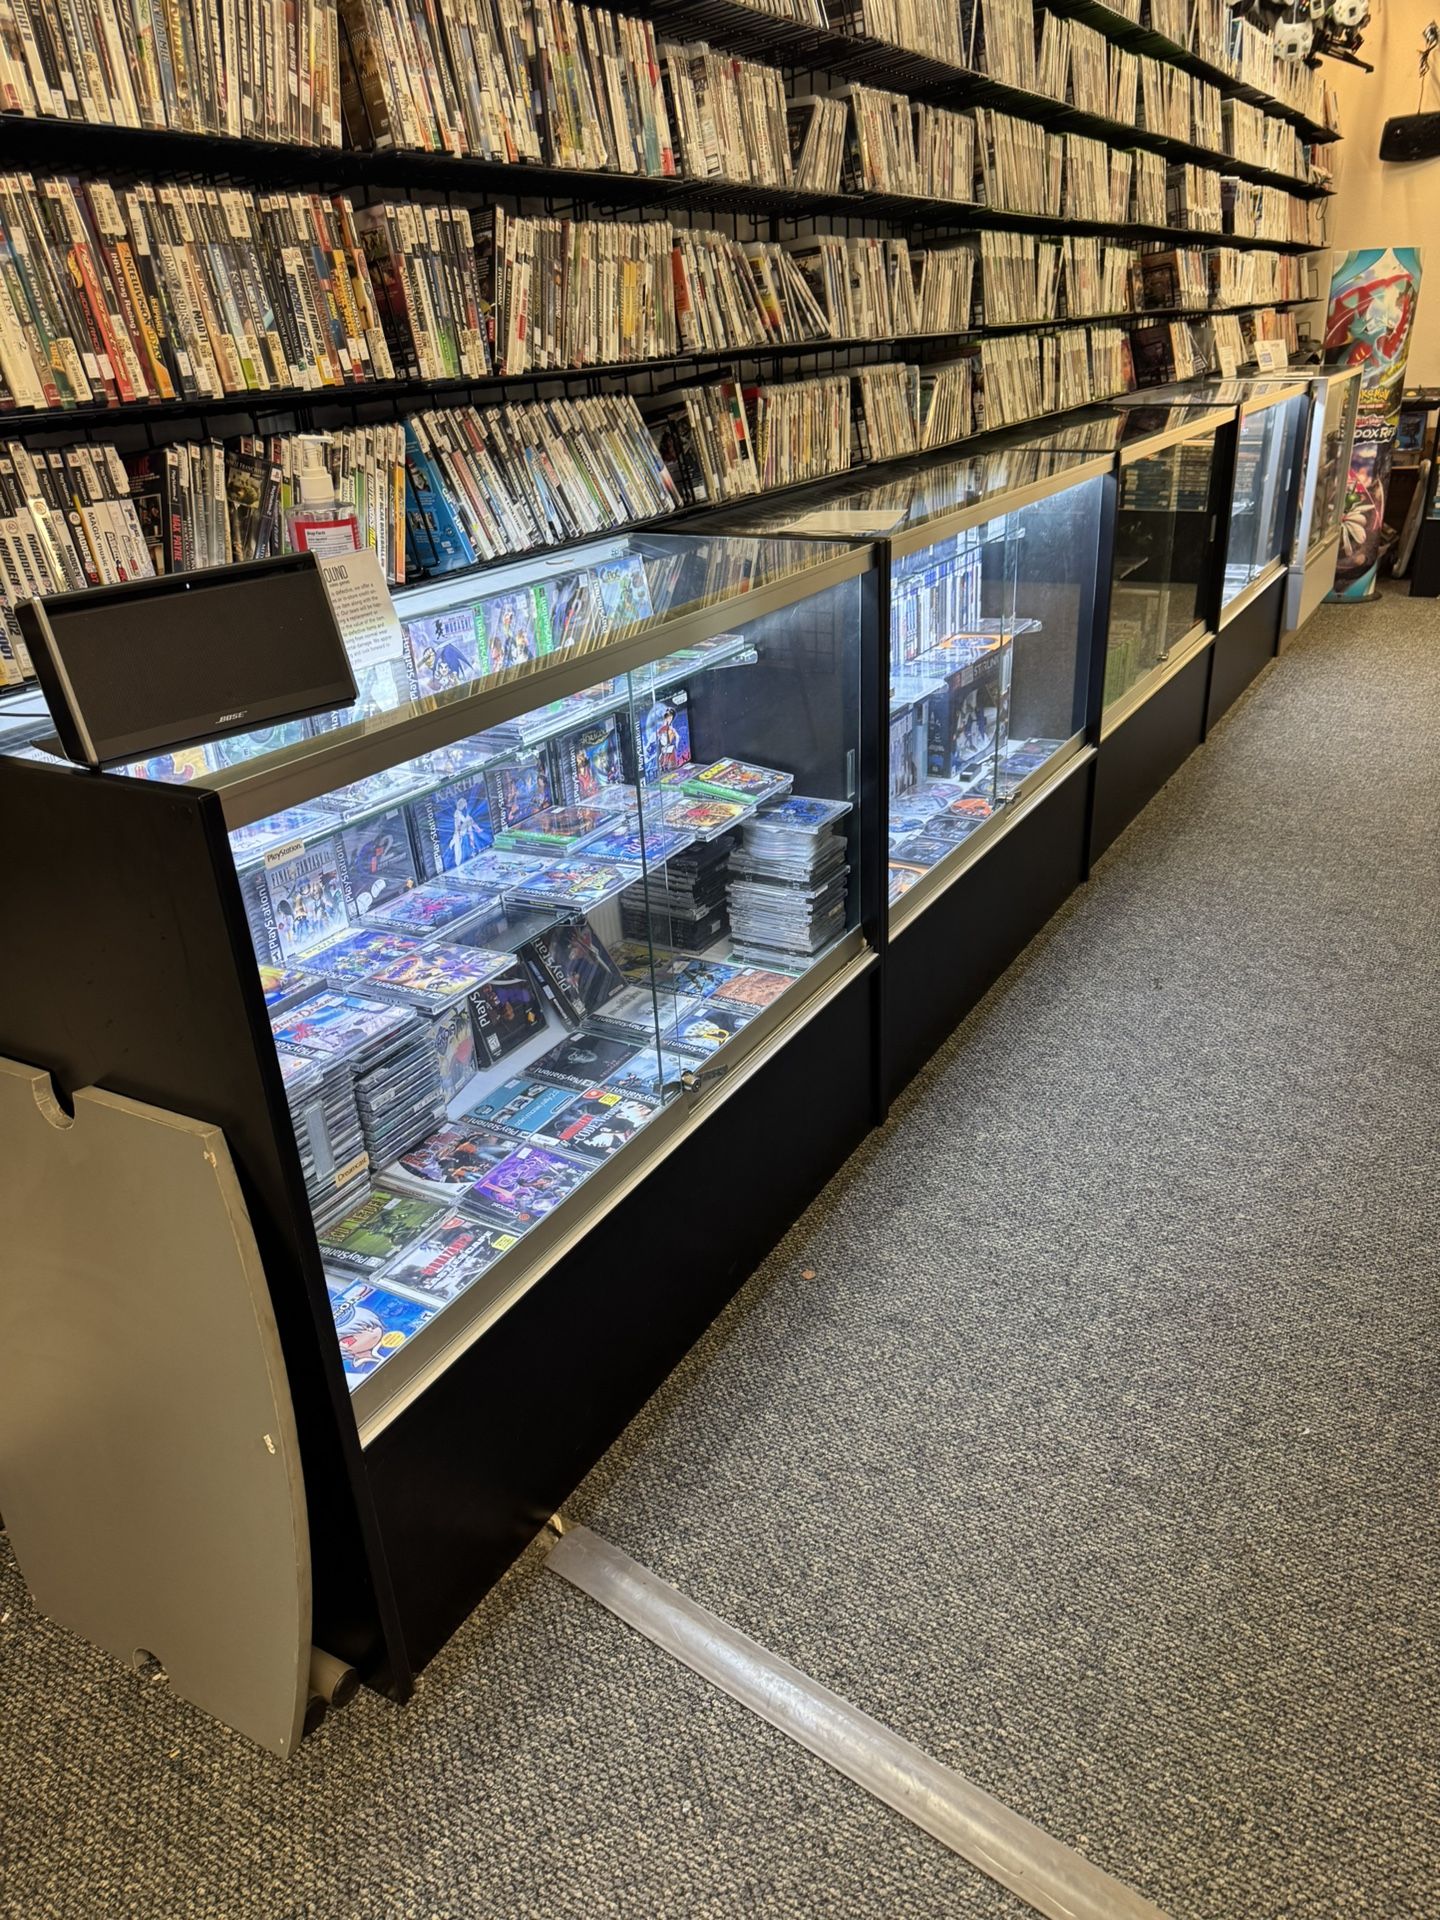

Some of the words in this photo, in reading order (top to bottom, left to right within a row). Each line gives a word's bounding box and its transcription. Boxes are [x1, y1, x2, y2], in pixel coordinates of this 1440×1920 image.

[53, 203, 67, 235] PlayStation
[167, 208, 180, 238] PlayStation
[110, 251, 122, 275] IHRA
[160, 249, 180, 287] JIMMY
[179, 257, 192, 281] JONNY
[211, 248, 230, 288] Katamari
[116, 276, 129, 298] Drag
[185, 281, 200, 309] MOSELEY
[296, 263, 315, 312] KNOCKOUT
[308, 312, 323, 341] KINGS
[28, 276, 44, 309] SHOTS
[38, 309, 53, 339] GOLF
[122, 298, 138, 329] Racing
[192, 308, 207, 332] MAD
[286, 271, 305, 321] KNOCKOUT
[298, 322, 311, 346] KINGS
[273, 301, 287, 334] KINGDOM
[282, 335, 294, 362] HEARTS
[286, 312, 299, 345] KINGDOM
[444, 456, 457, 478] Tekken
[572, 438, 595, 474] WITHOUT
[172, 513, 180, 532] MAX
[440, 487, 454, 503] CAT
[452, 515, 466, 534] HAT
[27, 532, 48, 578] MADDEN
[74, 526, 91, 562] MADDEN
[86, 511, 102, 541] MAGIX
[96, 542, 108, 566] music
[173, 535, 182, 560] PAYNE
[0, 537, 20, 586] MADDEN
[11, 534, 34, 582] MADDEN
[64, 544, 81, 577] MADDEN
[2, 606, 21, 636] 2002
[215, 711, 248, 724] BOSE
[425, 802, 444, 868] PlayStation
[266, 842, 302, 863] PlayStation
[271, 868, 291, 888] FINAL
[295, 854, 325, 877] FANTASY
[336, 841, 355, 904] PlayStation
[259, 886, 281, 956] PlayStation
[535, 1066, 583, 1087] PlayStation
[467, 1115, 519, 1137] PlayStation
[337, 1156, 368, 1182] Dreamcast
[320, 1245, 369, 1266] PlayStation
